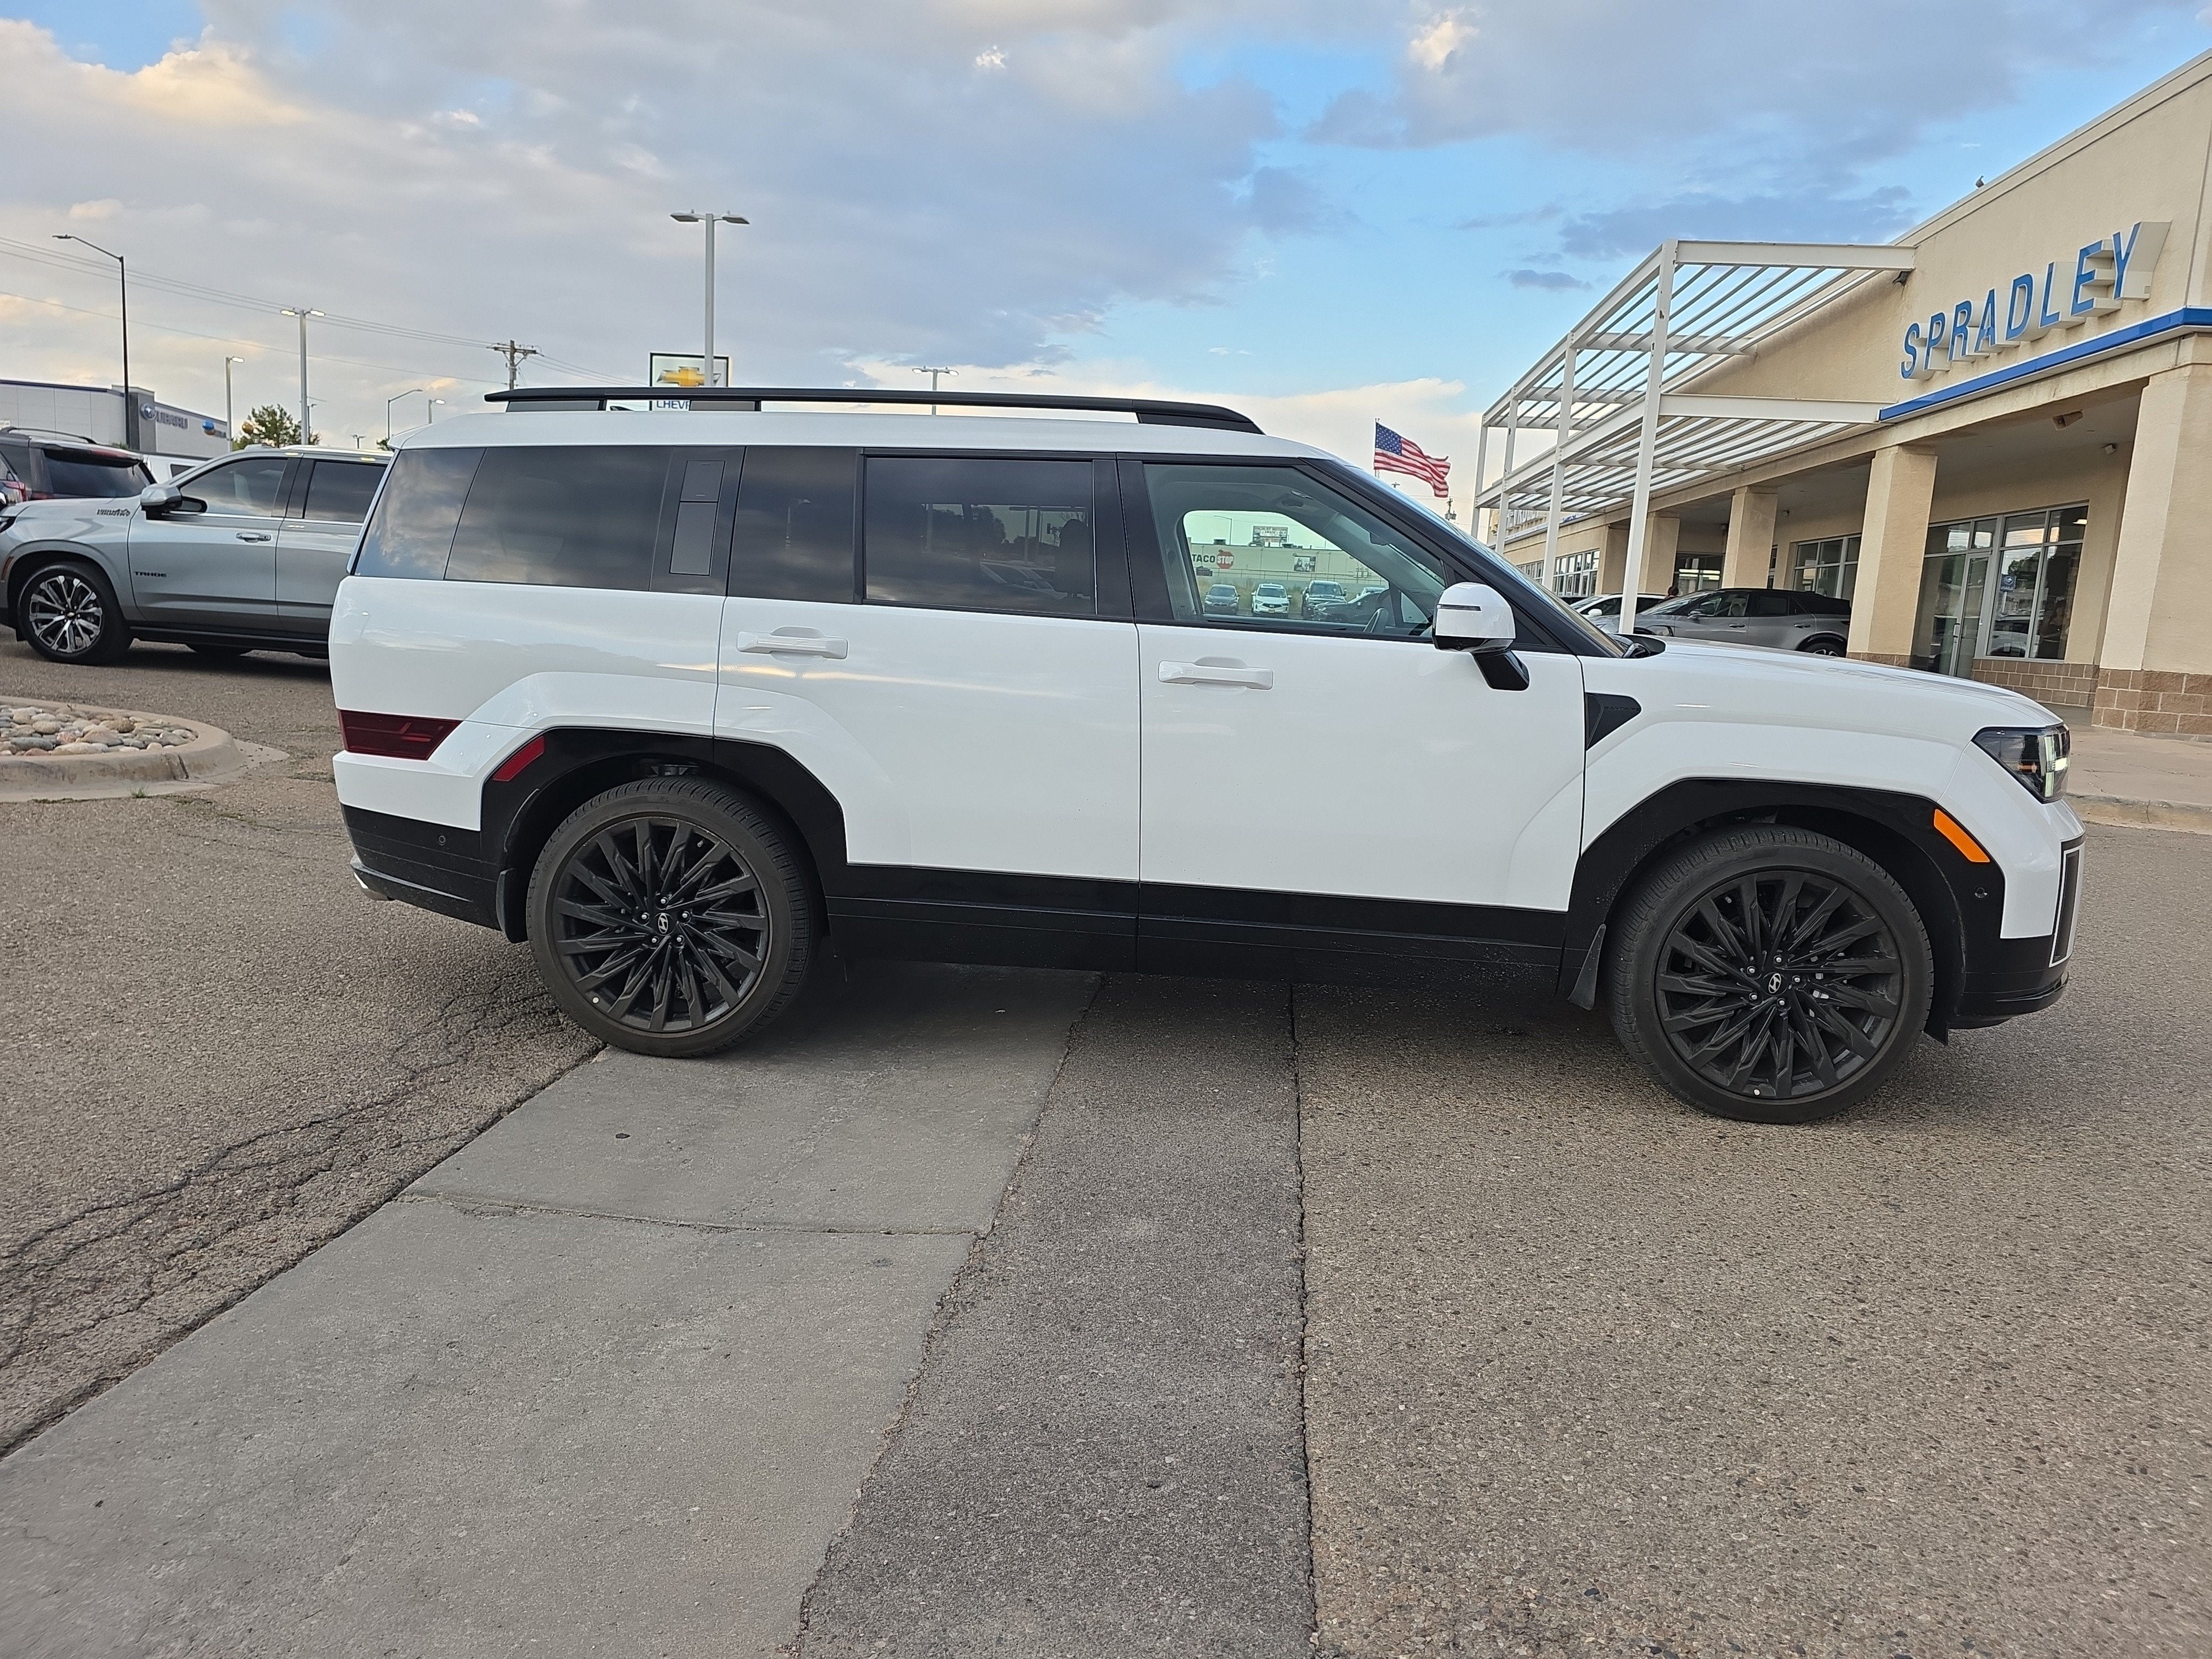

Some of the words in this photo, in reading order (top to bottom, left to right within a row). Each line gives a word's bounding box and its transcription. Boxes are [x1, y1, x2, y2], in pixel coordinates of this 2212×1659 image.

[1900, 221, 2143, 380] SPRADLEY
[157, 411, 188, 429] UBARU
[1192, 554, 1216, 563] TACO
[1217, 556, 1234, 564] STOP
